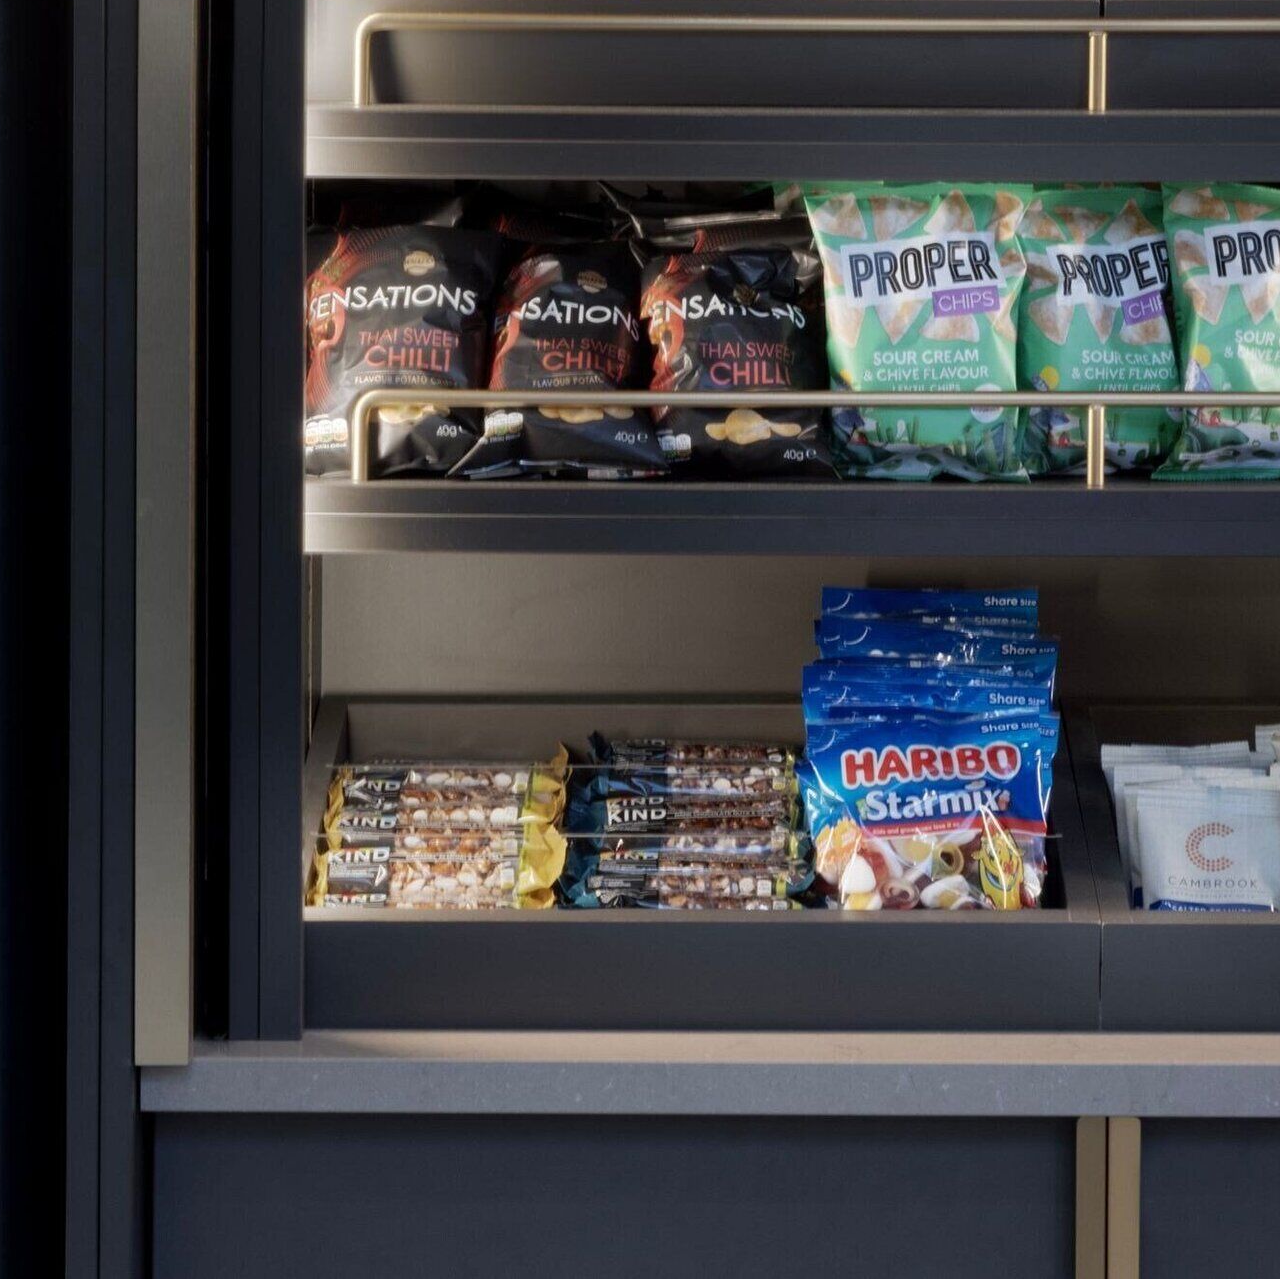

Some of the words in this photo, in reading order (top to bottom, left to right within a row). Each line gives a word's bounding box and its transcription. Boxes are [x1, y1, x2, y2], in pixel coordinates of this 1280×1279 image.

[849, 238, 999, 299] PROPER
[1057, 236, 1171, 298] PROPER
[310, 284, 478, 318] SENSATIONS
[938, 290, 995, 313] CHIPS
[359, 328, 397, 346] THAI
[403, 328, 460, 348] SWEET
[1236, 331, 1275, 346] SOUR
[700, 343, 740, 358] THAI
[873, 350, 917, 366] SOUR
[922, 348, 980, 365] CREAM
[1081, 350, 1121, 366] SOUR
[365, 345, 451, 372] CHILLI
[542, 352, 625, 382] CHILLI
[877, 367, 921, 382] CHIVE
[923, 364, 989, 381] FLAVOUR
[1086, 367, 1127, 382] CHIVE
[354, 374, 391, 385] FLAVOUR
[395, 375, 428, 385] POTATO
[532, 377, 570, 387] FLAVOUR
[436, 424, 458, 438] 40g
[615, 430, 635, 445] 40g
[783, 448, 804, 461] 40g
[984, 596, 1018, 607] Share
[1001, 644, 1037, 656] Share
[989, 692, 1025, 705] Share
[1027, 697, 1046, 706] Size
[981, 721, 1018, 734] Share
[842, 743, 1020, 788] HARIBO
[865, 787, 1001, 821] Starmix
[339, 815, 397, 829] KIND
[608, 808, 667, 826] KIND
[327, 846, 390, 865] KIND
[1168, 876, 1258, 889] CAMBROOK
